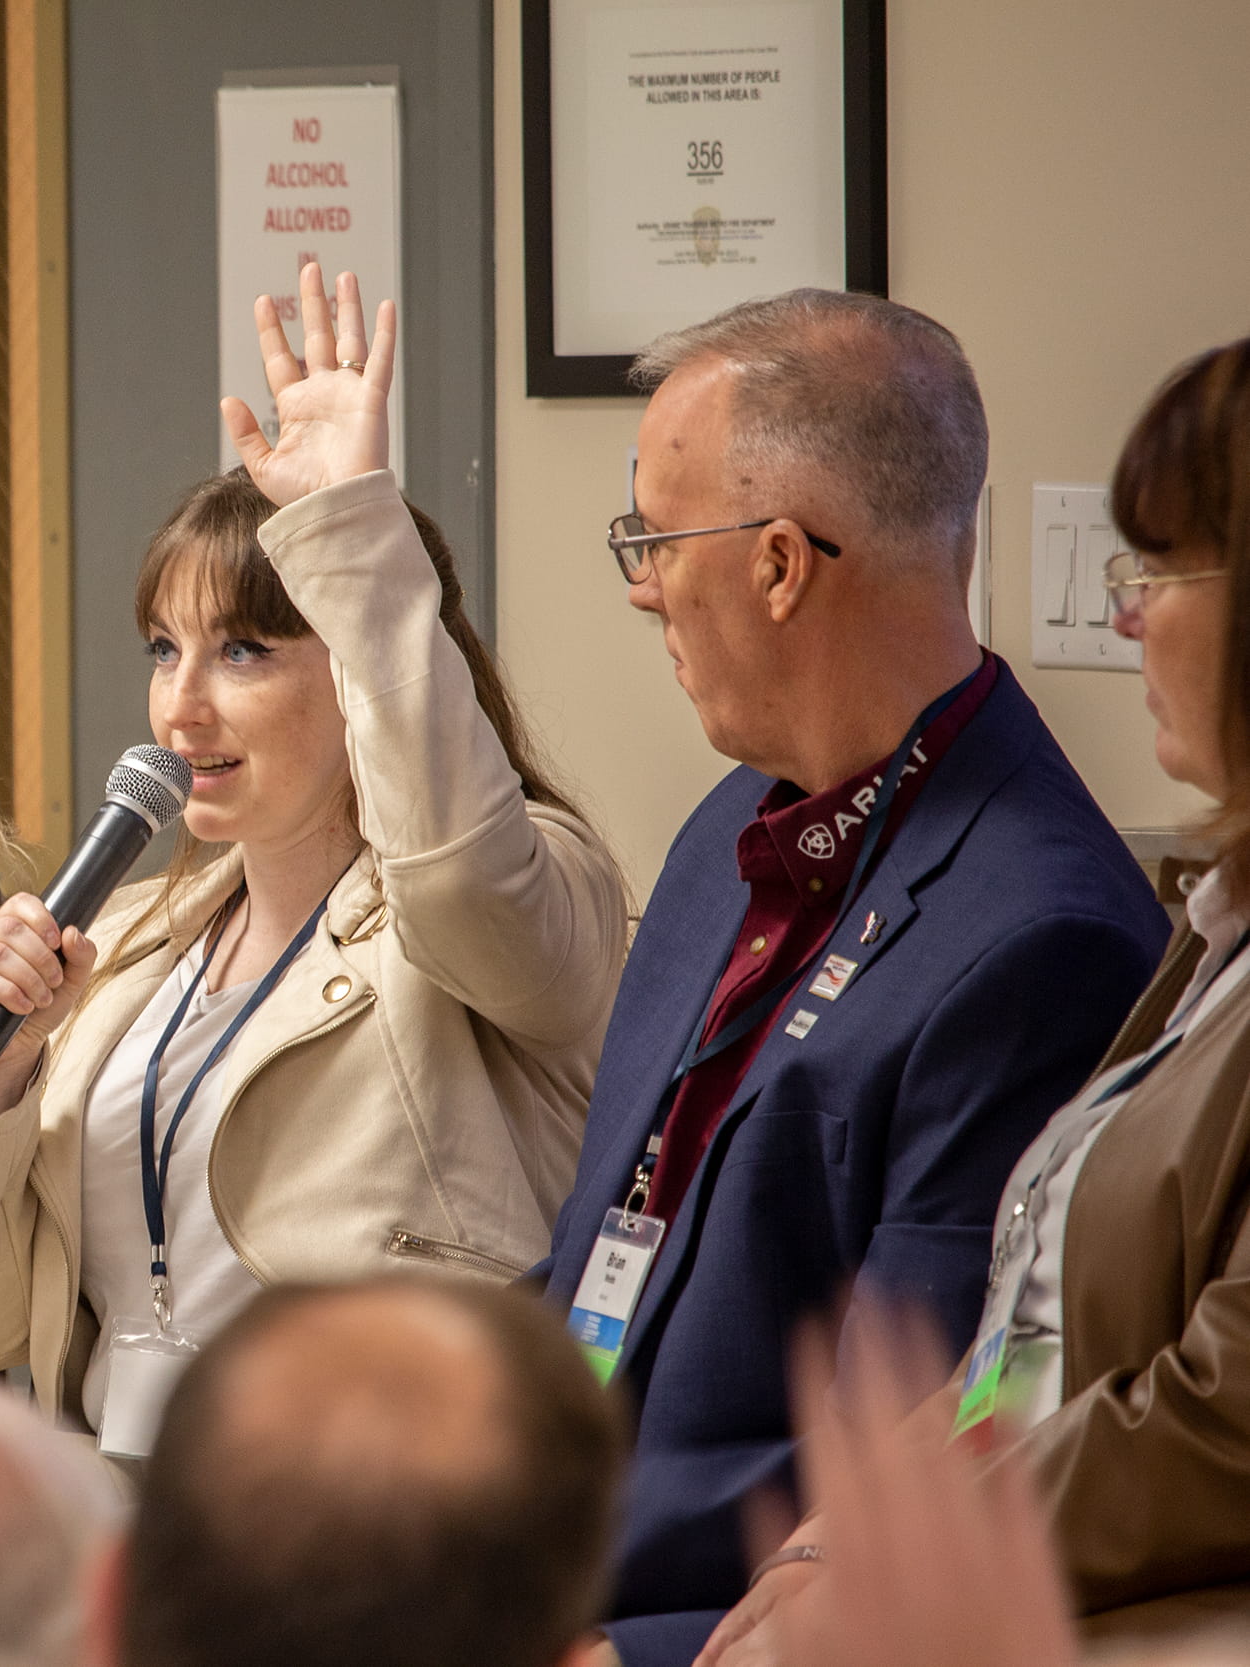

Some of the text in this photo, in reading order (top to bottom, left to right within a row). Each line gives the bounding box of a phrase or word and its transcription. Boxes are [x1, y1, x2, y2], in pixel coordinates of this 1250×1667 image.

[628, 69, 780, 88] THE MAXIMUM NUMBER OF PEOPLE
[646, 91, 689, 104] ALLOWED
[691, 91, 700, 103] IN
[703, 90, 721, 102] THIS
[724, 88, 748, 101] AREA
[292, 117, 321, 143] NO
[687, 141, 723, 170] 356
[265, 161, 348, 188] ALCOHOL
[263, 206, 352, 233] ALLOWED
